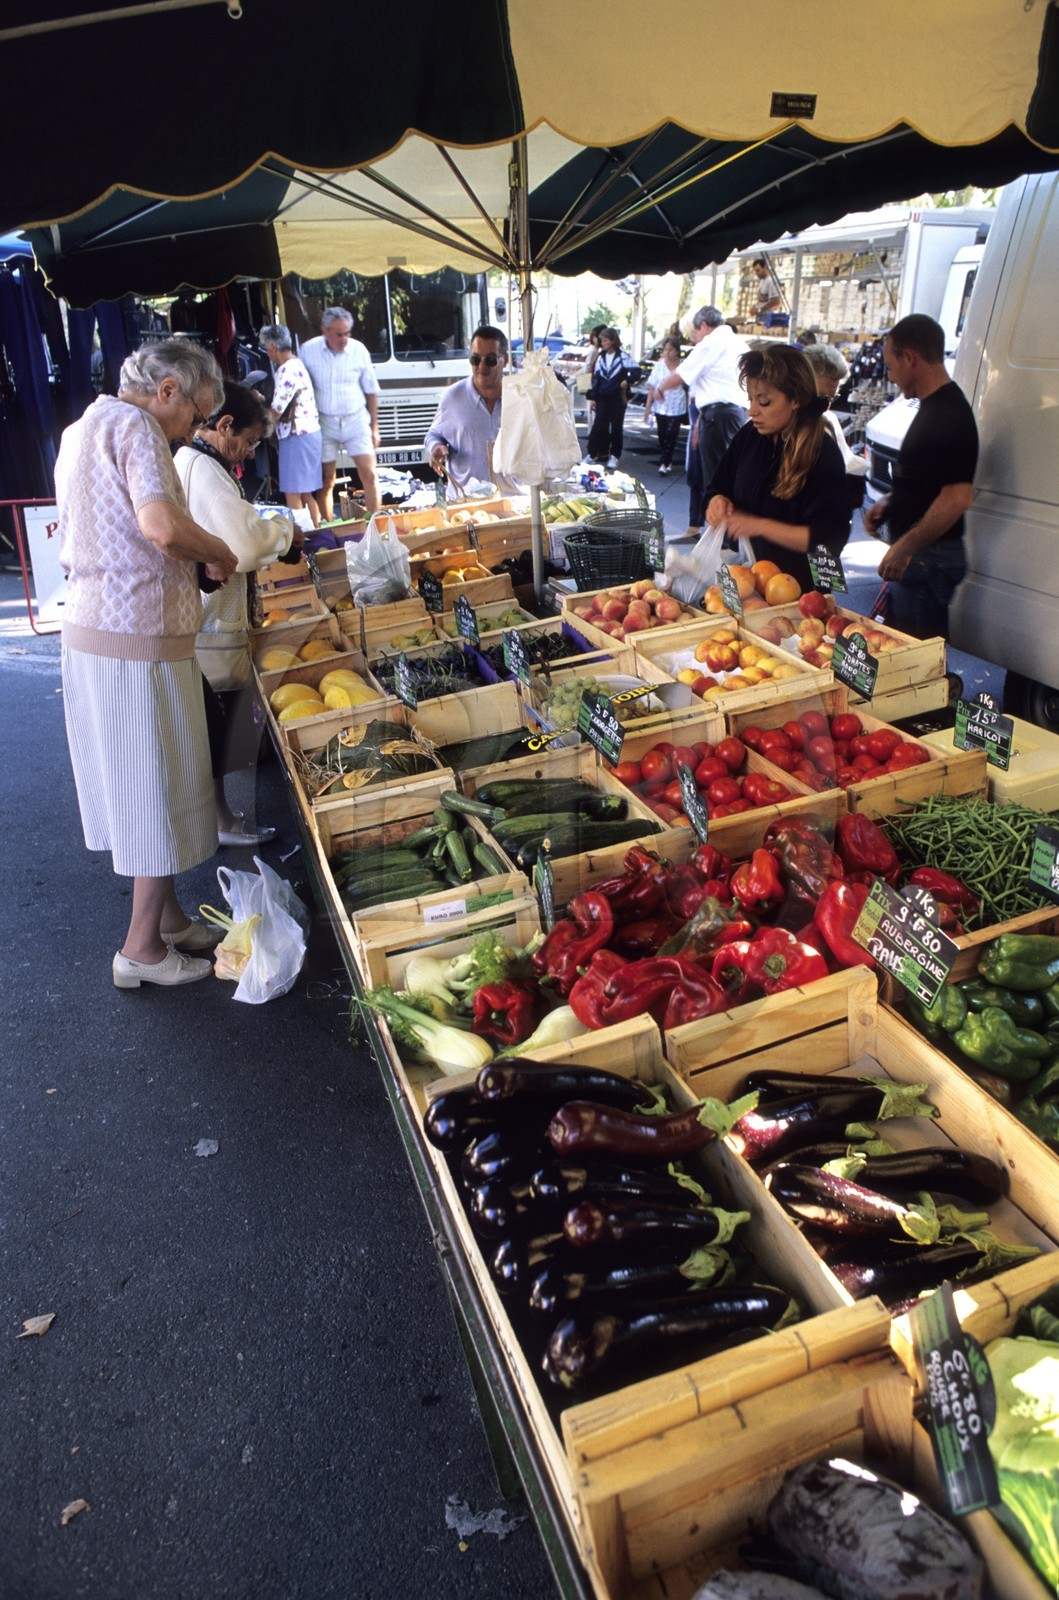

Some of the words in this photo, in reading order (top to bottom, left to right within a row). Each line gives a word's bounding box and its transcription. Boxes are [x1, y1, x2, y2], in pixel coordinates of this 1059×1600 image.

[844, 651, 870, 674] TOMATES
[957, 700, 970, 717] Prix
[980, 694, 994, 709] 1Kg
[967, 722, 1007, 744] HARICOT
[870, 880, 892, 911] Prix
[915, 889, 935, 918] 1Kg
[930, 1349, 950, 1418] ROUGE
[943, 1360, 970, 1452] CHOUX
